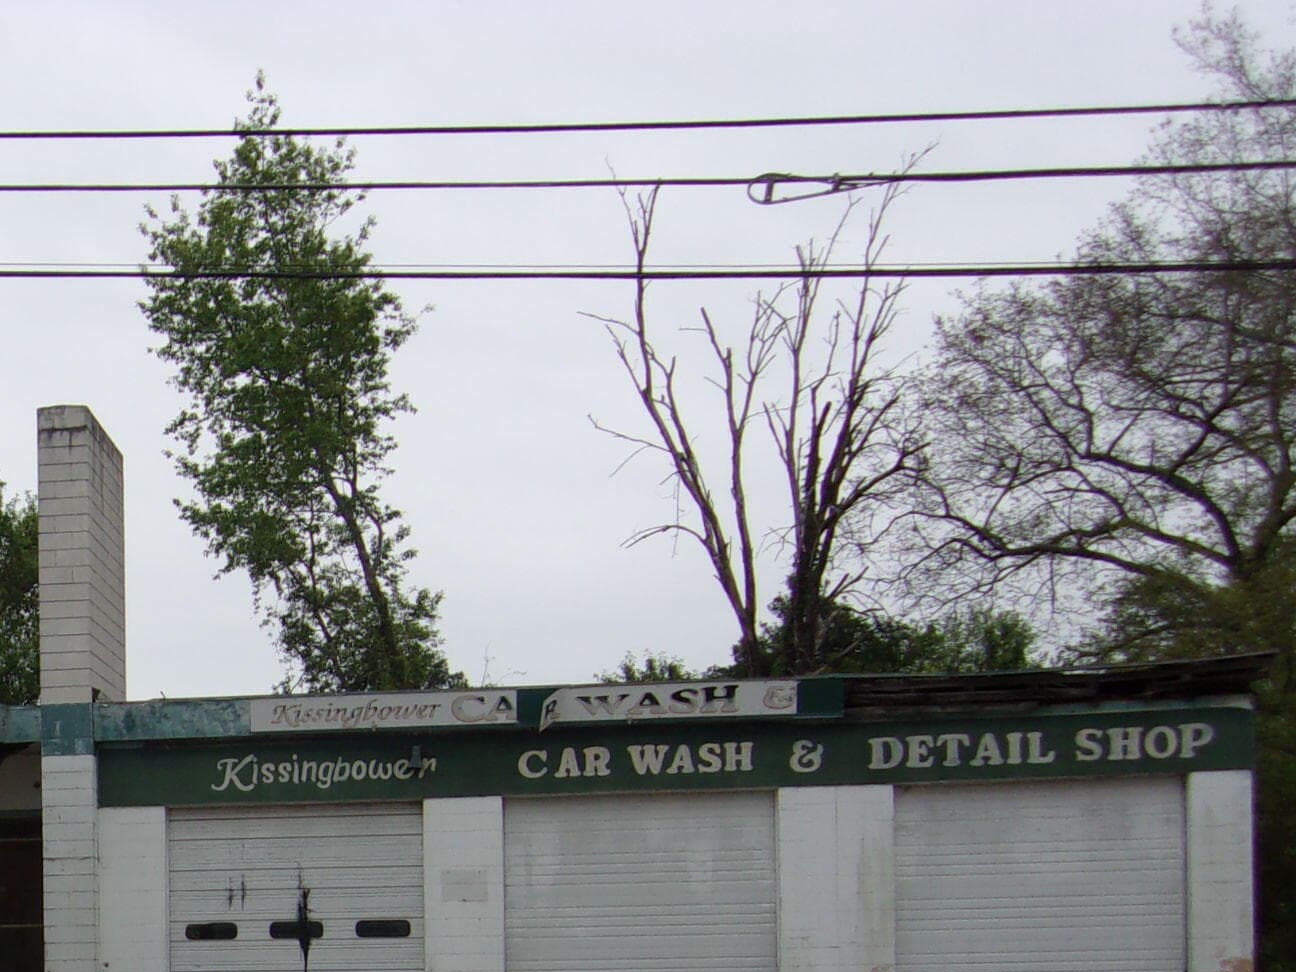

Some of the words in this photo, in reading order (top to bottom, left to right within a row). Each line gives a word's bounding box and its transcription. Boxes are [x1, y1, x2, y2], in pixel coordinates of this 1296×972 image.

[270, 699, 442, 729] Kissingbower
[576, 684, 740, 716] WASH
[211, 754, 437, 791] Kissingbower
[517, 746, 611, 779] CAR
[626, 741, 754, 776] WASH
[789, 739, 824, 773] &
[868, 731, 1055, 770] DETAIL
[1075, 722, 1214, 762] SHOP
